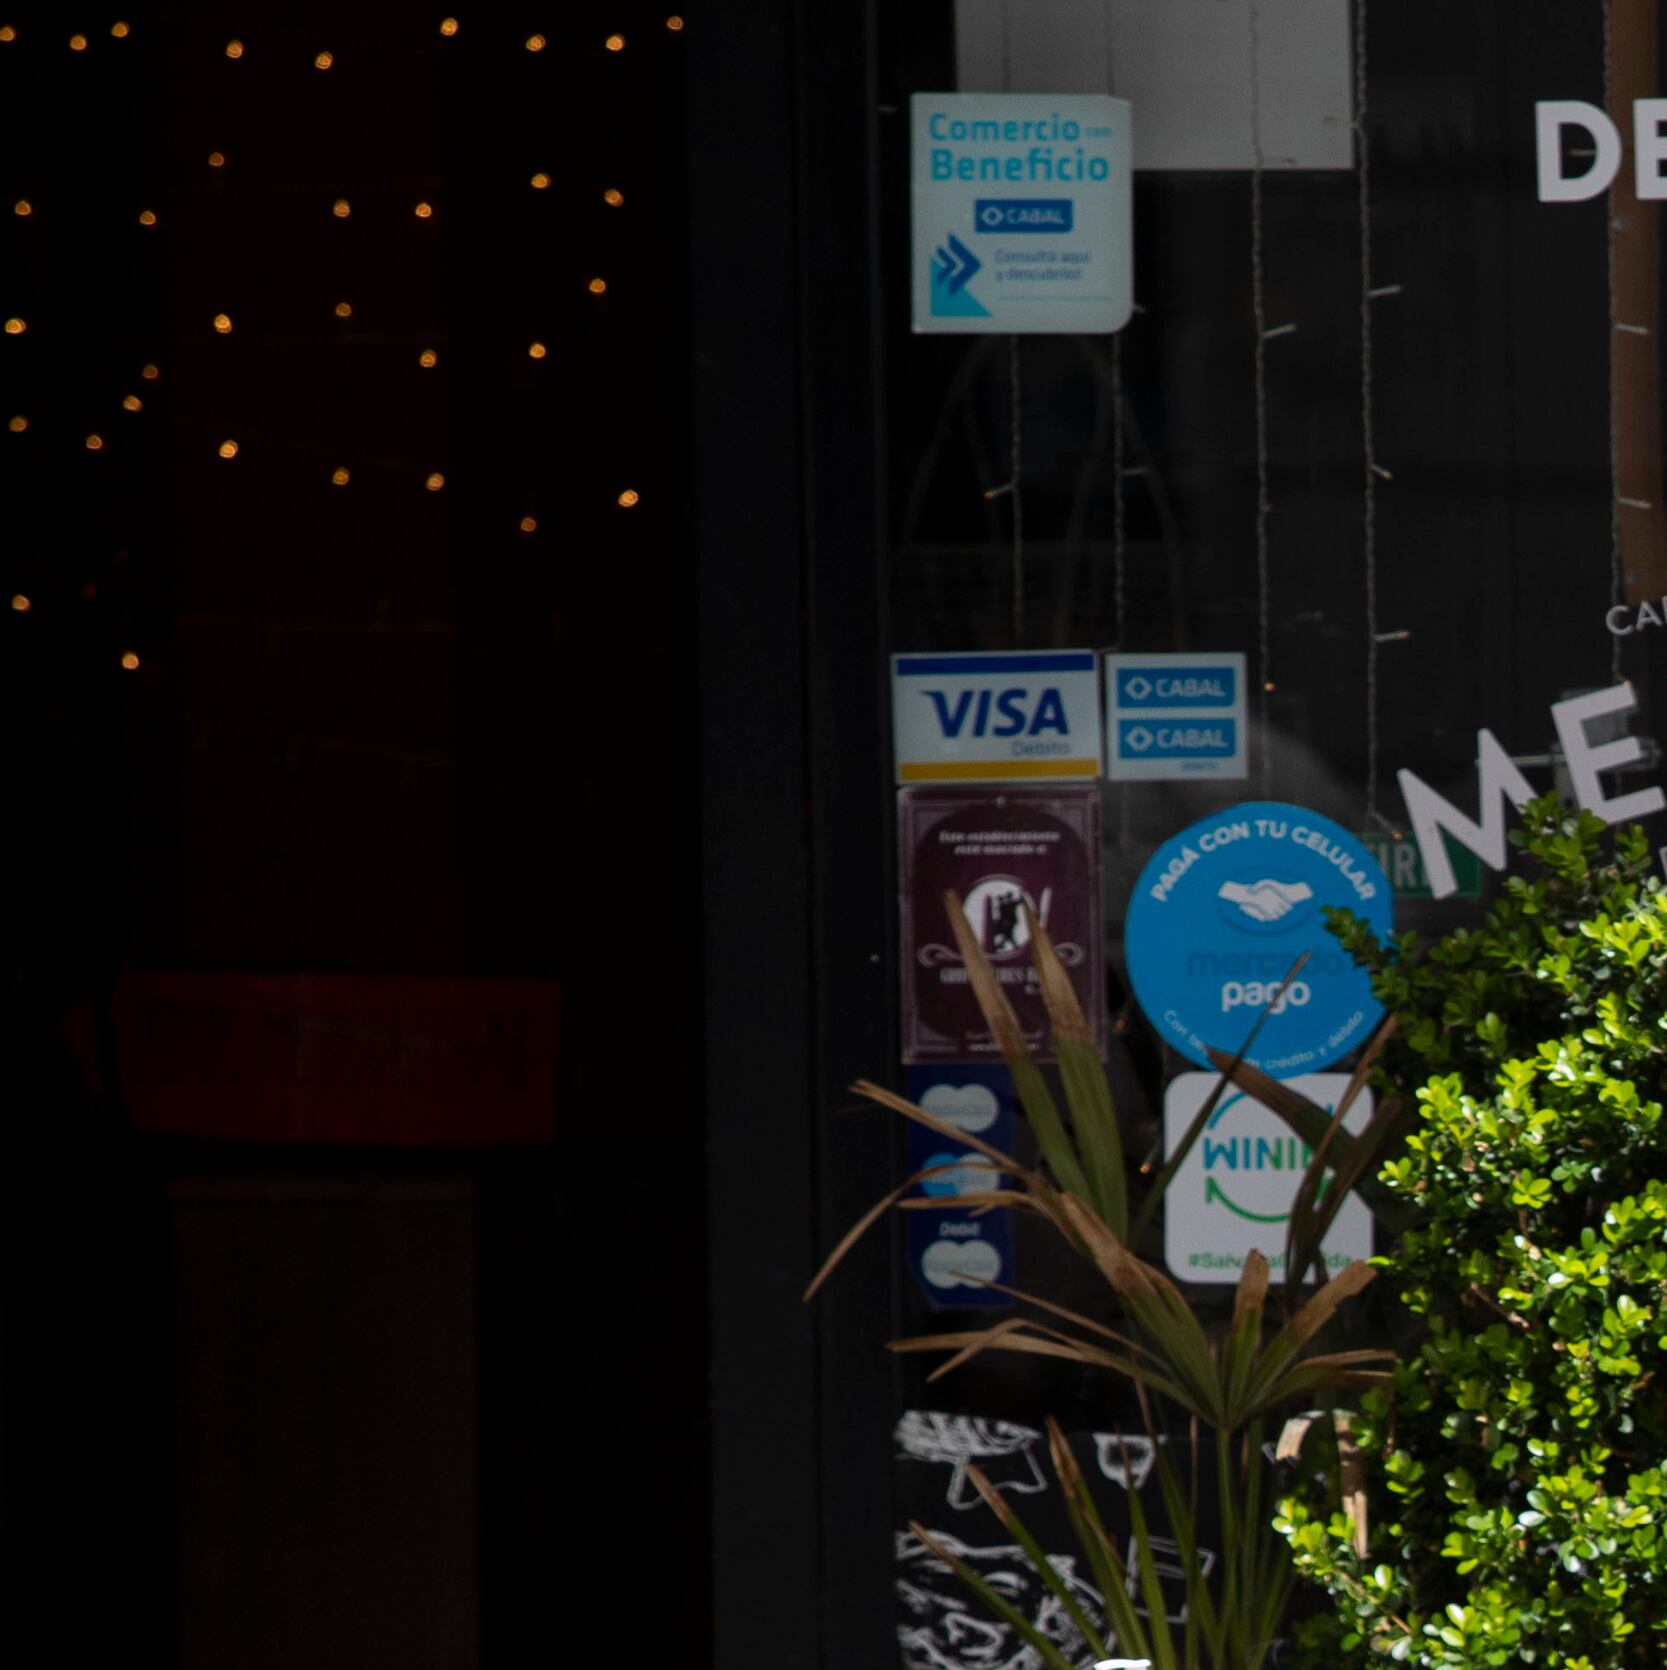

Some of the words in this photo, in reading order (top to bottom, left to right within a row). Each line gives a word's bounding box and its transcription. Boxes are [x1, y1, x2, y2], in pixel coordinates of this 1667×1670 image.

[929, 112, 1081, 142] Comercio
[930, 148, 1110, 182] Beneficio
[1155, 677, 1227, 698] CABAL
[922, 686, 1070, 738] VISA
[1156, 728, 1228, 749] CABAL
[1150, 842, 1201, 904] PAGÁ
[1198, 819, 1251, 854] CON
[1254, 818, 1289, 840] TU
[1290, 824, 1378, 901] CELULAR
[1220, 979, 1312, 1016] pago
